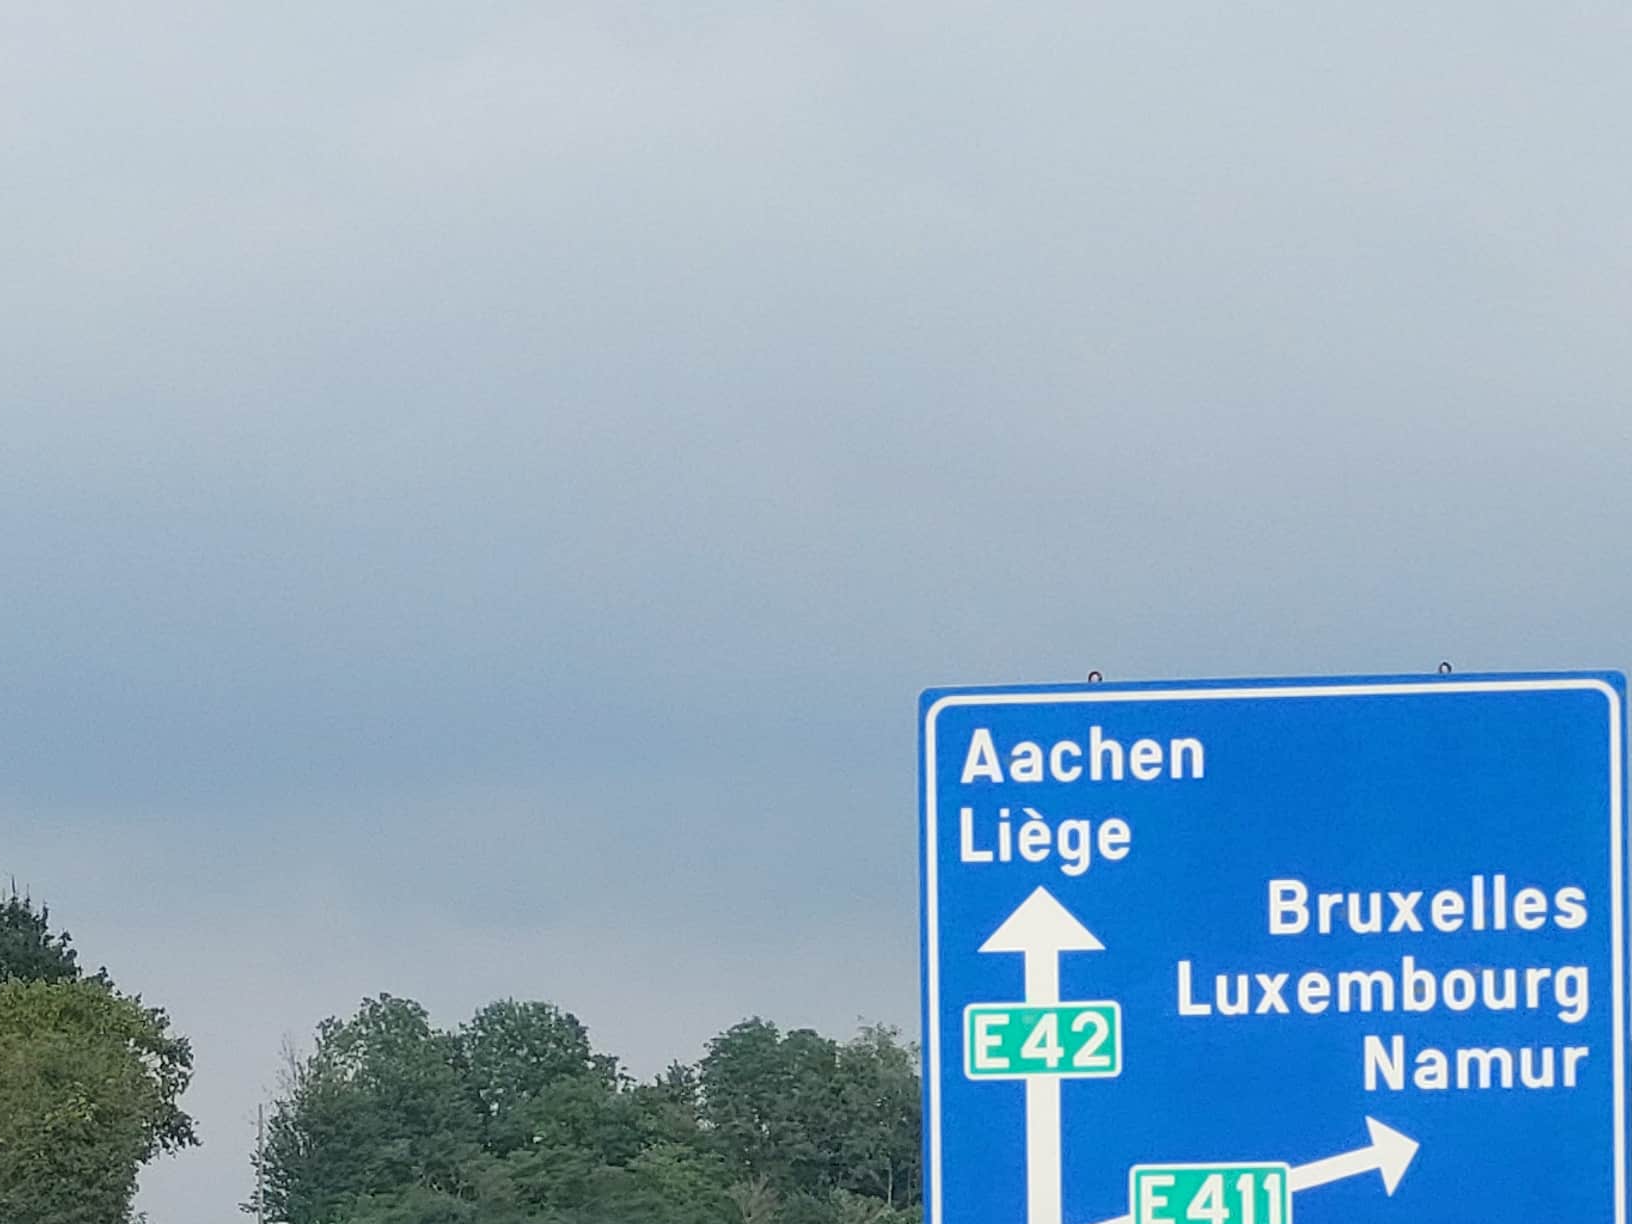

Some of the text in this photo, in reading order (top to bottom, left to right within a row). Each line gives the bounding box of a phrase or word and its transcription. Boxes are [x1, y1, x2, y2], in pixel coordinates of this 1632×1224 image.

[960, 725, 1204, 784] Aachen
[960, 807, 1131, 876] Liège
[1269, 874, 1588, 935] Bruxelles
[1177, 955, 1589, 1023] Luxembourg
[1364, 1034, 1589, 1091] Namur
